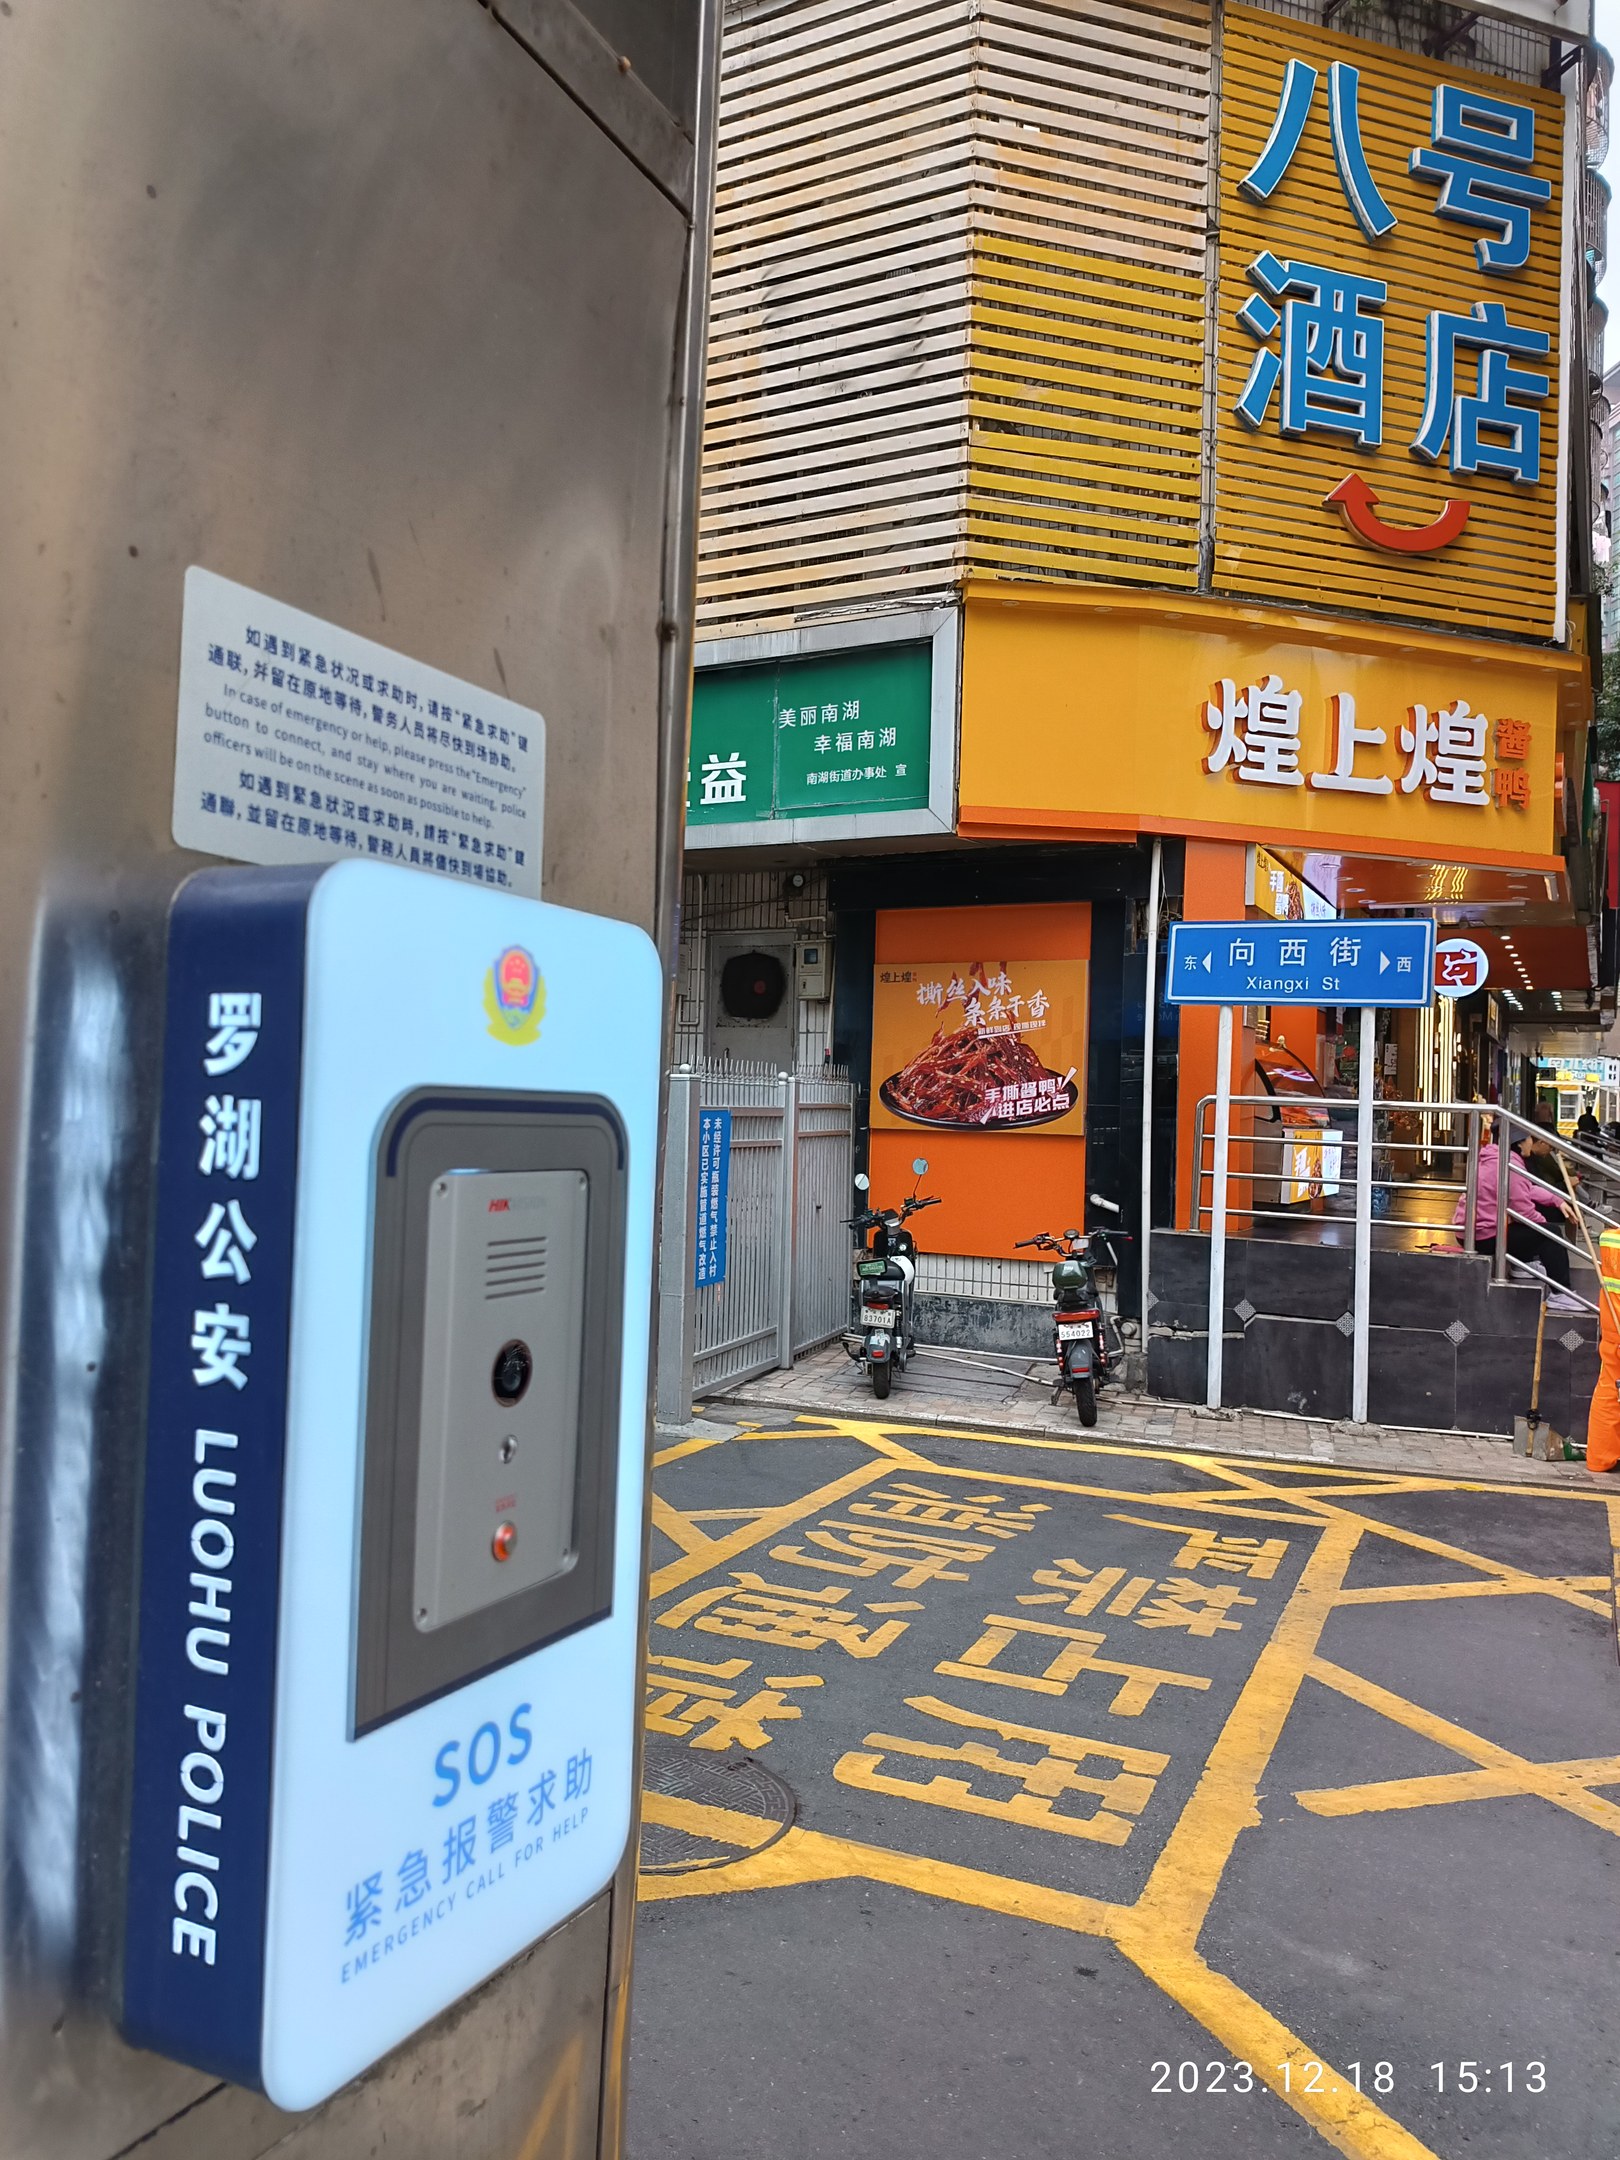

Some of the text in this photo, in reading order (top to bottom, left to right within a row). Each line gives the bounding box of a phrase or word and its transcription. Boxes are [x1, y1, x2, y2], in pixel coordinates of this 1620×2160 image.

[1236, 58, 1552, 273] 八号
[1232, 250, 1551, 486] 酒店
[205, 702, 249, 729] button
[255, 721, 269, 735] to
[331, 747, 352, 762] and
[357, 753, 379, 774] stay
[383, 763, 415, 783] where
[419, 775, 437, 791] you
[442, 783, 457, 797] are
[501, 801, 527, 819] police
[223, 683, 238, 697] In
[239, 690, 267, 710] case
[270, 702, 283, 714] of
[285, 708, 349, 740] emergency
[351, 730, 363, 741] or
[394, 745, 427, 765] please
[428, 757, 454, 774] press
[456, 765, 471, 780] the
[777, 700, 860, 729] 美丽南湖
[813, 727, 897, 755] 幸福南湖
[1201, 674, 1532, 810] 煌上煌 酱鸭
[203, 731, 251, 756] officers
[254, 746, 277, 763] will
[279, 750, 294, 768] be
[296, 760, 311, 772] on
[312, 764, 332, 780] the
[334, 771, 365, 790] scene
[367, 780, 379, 794] as
[380, 785, 406, 801] soon
[407, 793, 418, 806] as
[420, 797, 459, 819] possible
[461, 809, 471, 821] to
[805, 763, 907, 786] 南湖街道办事处 宣
[916, 971, 1012, 1007] 撕丝入味
[1183, 936, 1413, 973] 东 向西街 西
[1246, 976, 1341, 994] Xiangxi St
[997, 1093, 1070, 1119] 进店必点
[190, 991, 263, 1392] 罗湖公安
[171, 1428, 239, 1967] LUOHU POLICE
[833, 1513, 1290, 1846] 严禁占用
[431, 1702, 533, 1808] SOS
[340, 1807, 589, 1985] EMERGENCY CALL FOR HELP
[343, 1747, 593, 1947] 紧急报警求助
